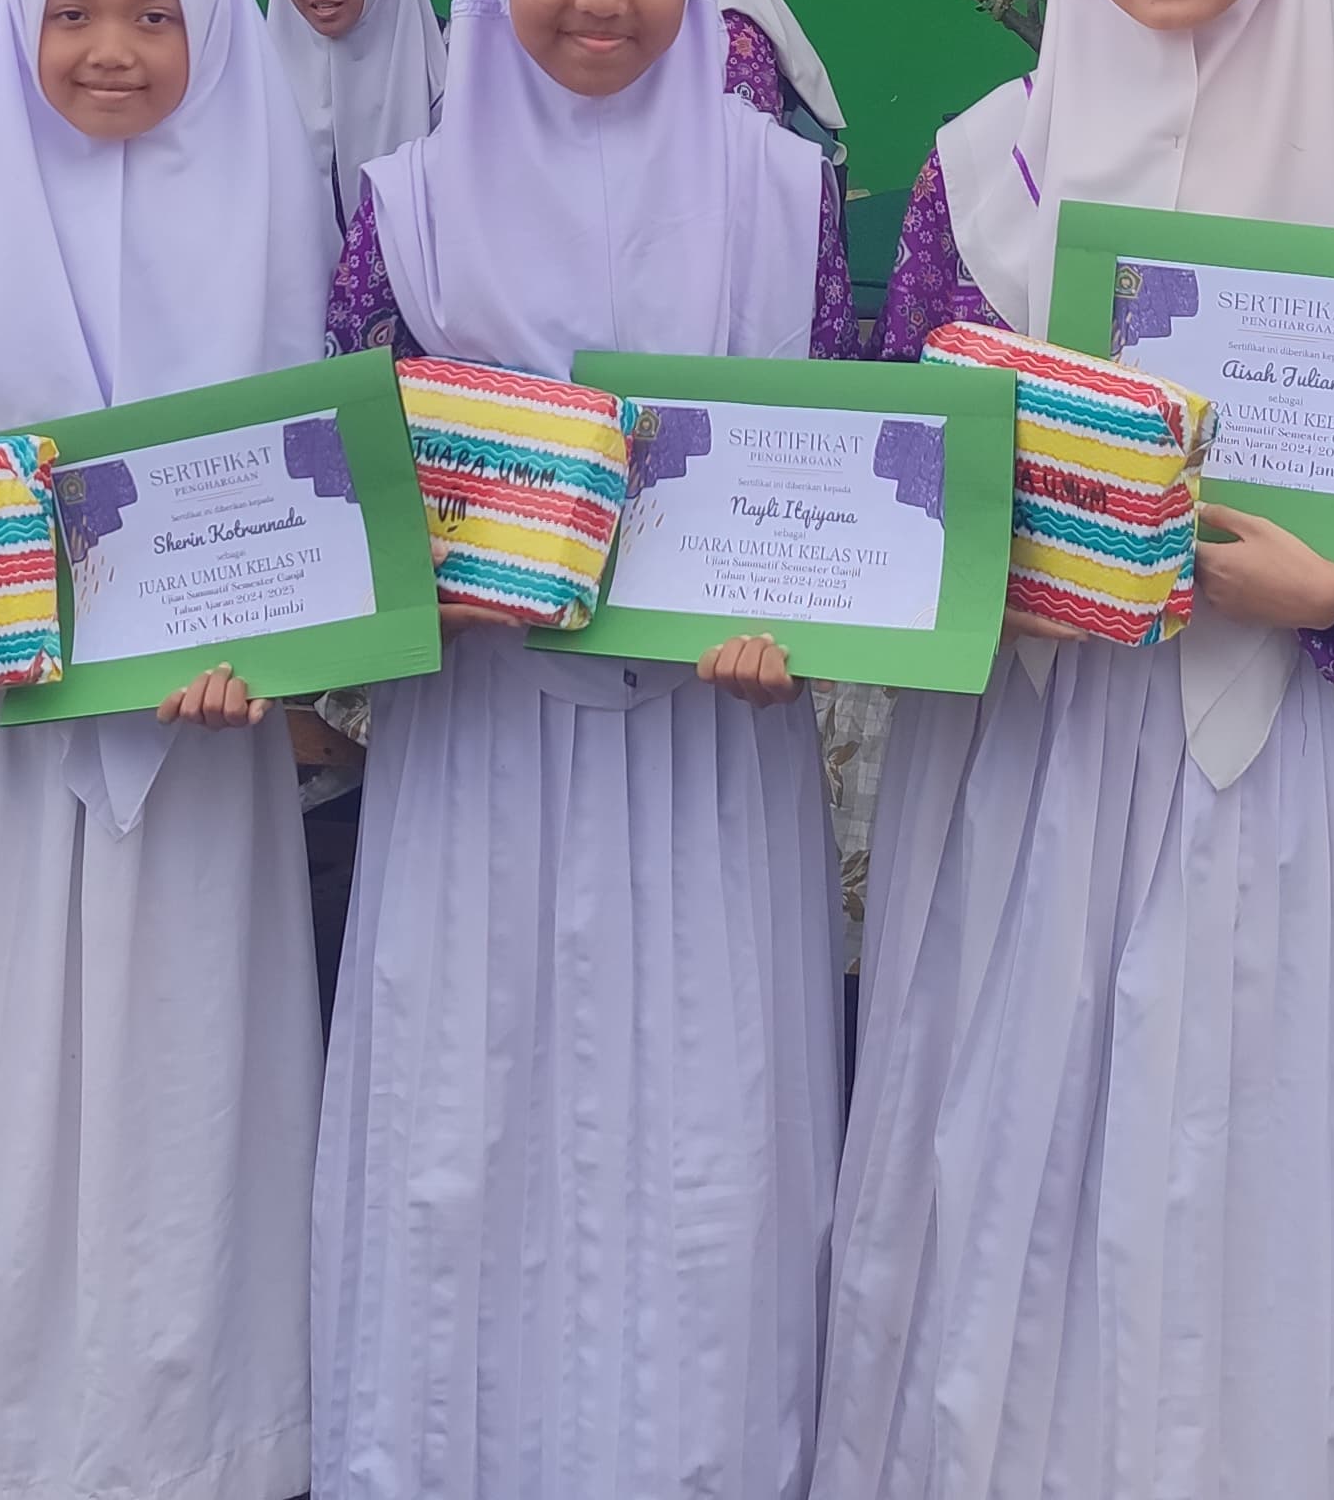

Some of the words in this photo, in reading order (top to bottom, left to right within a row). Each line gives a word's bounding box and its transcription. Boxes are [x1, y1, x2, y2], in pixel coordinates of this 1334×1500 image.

[1228, 341, 1265, 353] Sertifikat
[1267, 346, 1278, 354] ini
[1280, 347, 1320, 359] diberikan
[1223, 360, 1278, 383] Aisah
[1268, 394, 1304, 407] sebagai
[1238, 404, 1297, 425] UMUM
[729, 428, 864, 454] SERTIFIKAT
[1225, 421, 1276, 437] Summatif
[1278, 427, 1329, 443] Semester
[1244, 437, 1277, 450] Ajaran
[149, 446, 271, 487] SERTIFIKAT
[413, 436, 485, 477] JUARA
[499, 459, 557, 488] UMUM
[750, 451, 843, 467] PENGHARGAAN
[1250, 453, 1257, 466] 1
[1262, 454, 1304, 473] Kota
[174, 471, 259, 497] PENGHARGAAN
[738, 478, 771, 488] Sertifikat
[785, 481, 821, 492] diberikan
[824, 484, 851, 495] kepada
[731, 496, 780, 526] Nayli
[782, 499, 858, 530] Itqiyana
[153, 532, 206, 555] Sherin
[208, 508, 306, 543] Kotrunnada
[773, 529, 806, 540] sebagai
[679, 535, 733, 553] JUARA
[738, 539, 793, 558] UMUM
[798, 544, 851, 562] KELAS
[857, 549, 890, 565] VIII
[138, 575, 187, 598] JUARA
[192, 564, 242, 585] UMUM
[247, 553, 295, 574] KELAS
[297, 548, 321, 564] VII
[705, 555, 730, 567] Ujian
[781, 562, 828, 574] Semester
[831, 565, 861, 577] Ganjil
[232, 577, 274, 592] Semester
[715, 570, 745, 581] Tahun
[749, 571, 780, 585] Ajaran
[703, 583, 746, 600] MTsN
[753, 587, 760, 600] 1
[763, 589, 803, 605] Kota
[807, 593, 853, 609] Jambi
[166, 617, 208, 636] MTsN
[211, 612, 218, 627] 1
[222, 609, 259, 626] Kota
[264, 599, 304, 620] Jambi
